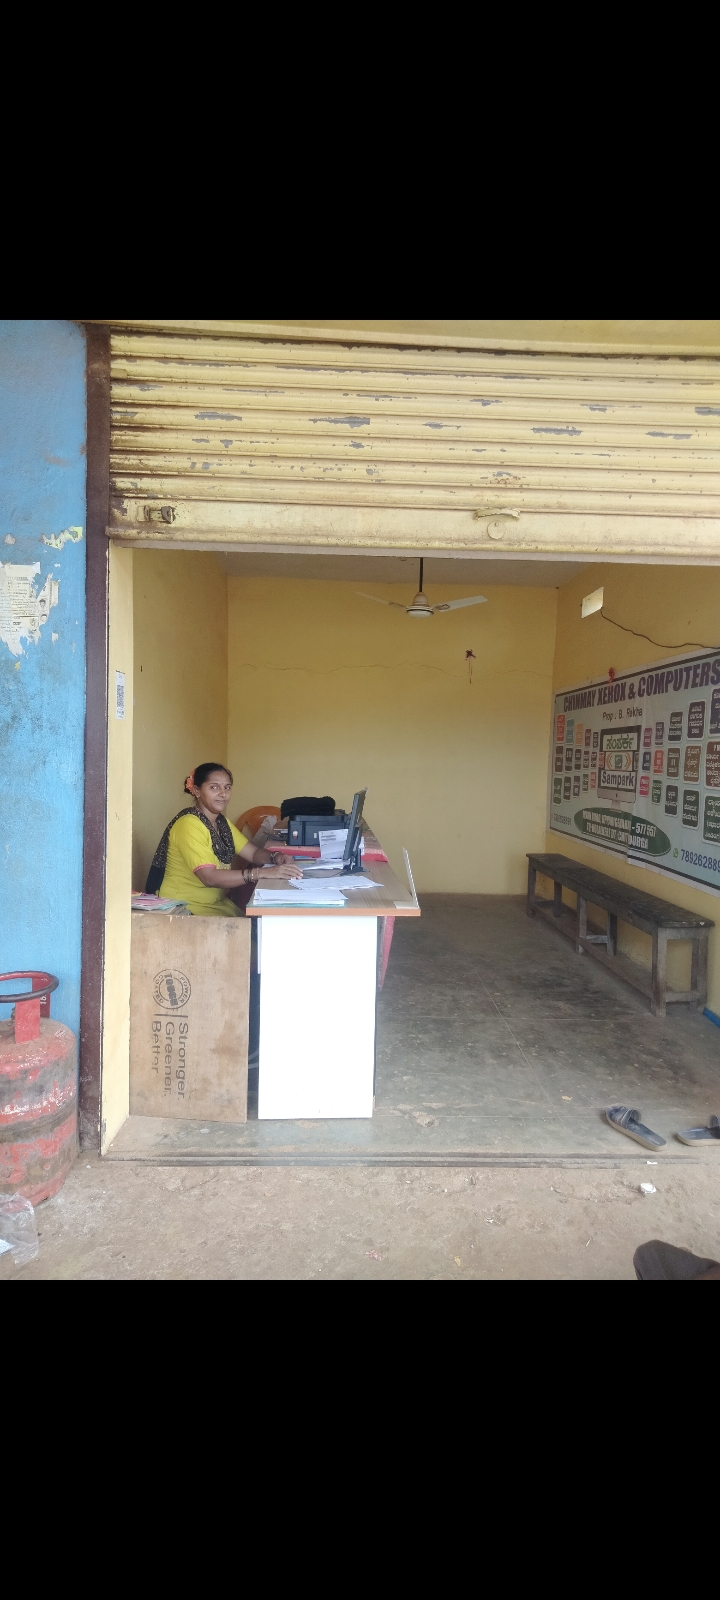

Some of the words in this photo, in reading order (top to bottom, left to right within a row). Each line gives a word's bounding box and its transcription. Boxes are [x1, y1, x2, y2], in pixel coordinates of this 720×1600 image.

[563, 689, 597, 713] CHINMAY
[628, 682, 636, 700] &
[638, 659, 720, 698] COMPUTERS
[601, 770, 635, 788] Sampark
[179, 976, 190, 1004] POWER
